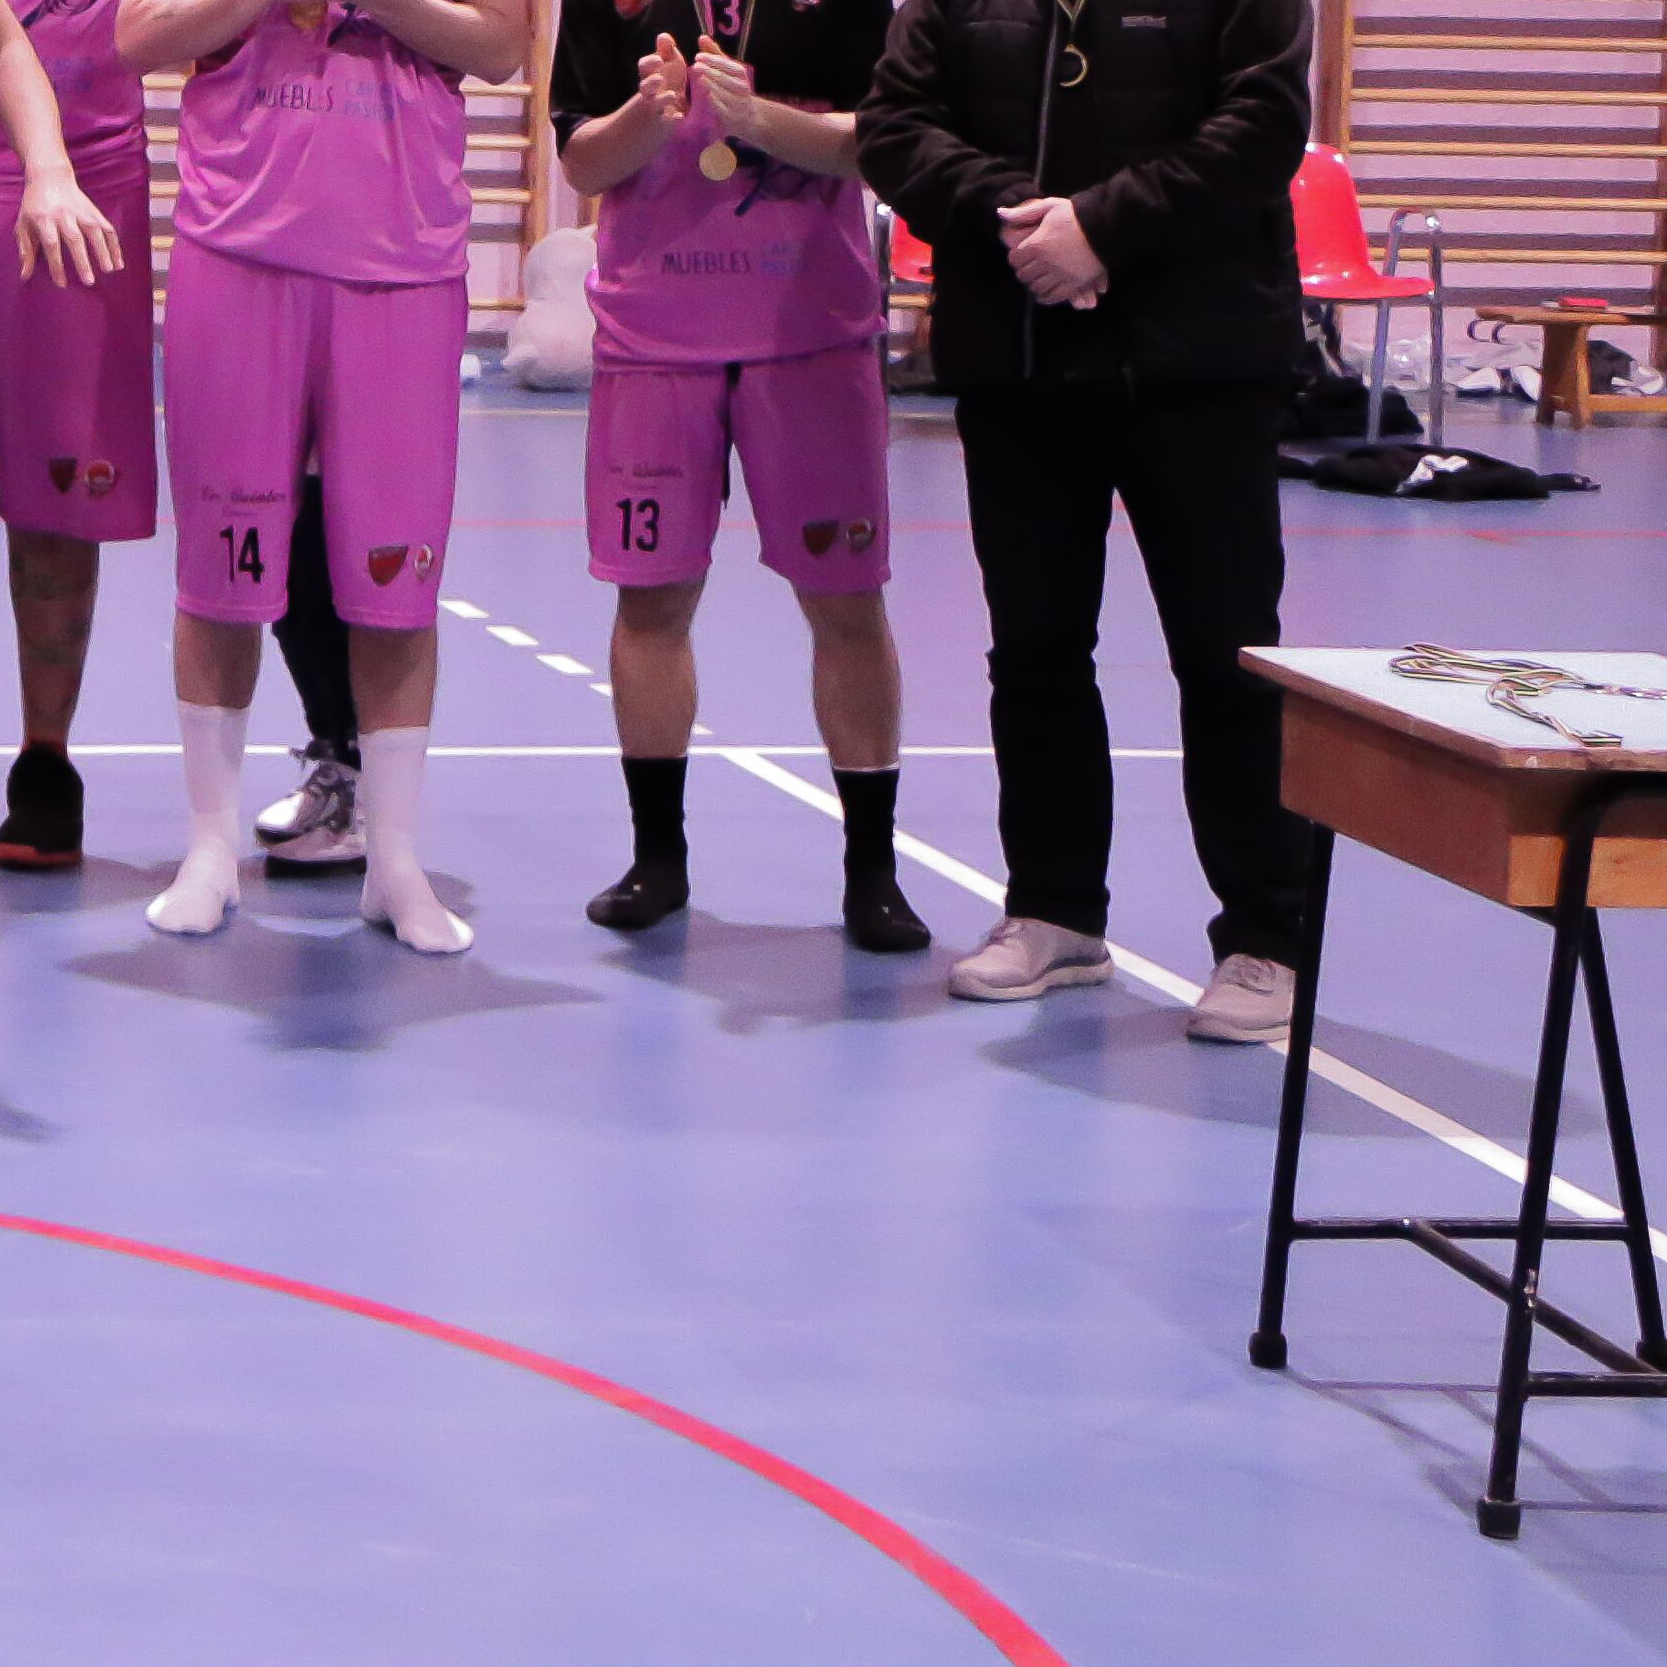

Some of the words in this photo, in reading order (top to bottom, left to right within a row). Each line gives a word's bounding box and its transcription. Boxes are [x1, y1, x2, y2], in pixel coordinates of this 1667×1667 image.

[661, 251, 751, 276] MUEBLES
[615, 498, 661, 552] 13
[219, 525, 265, 584] 14
